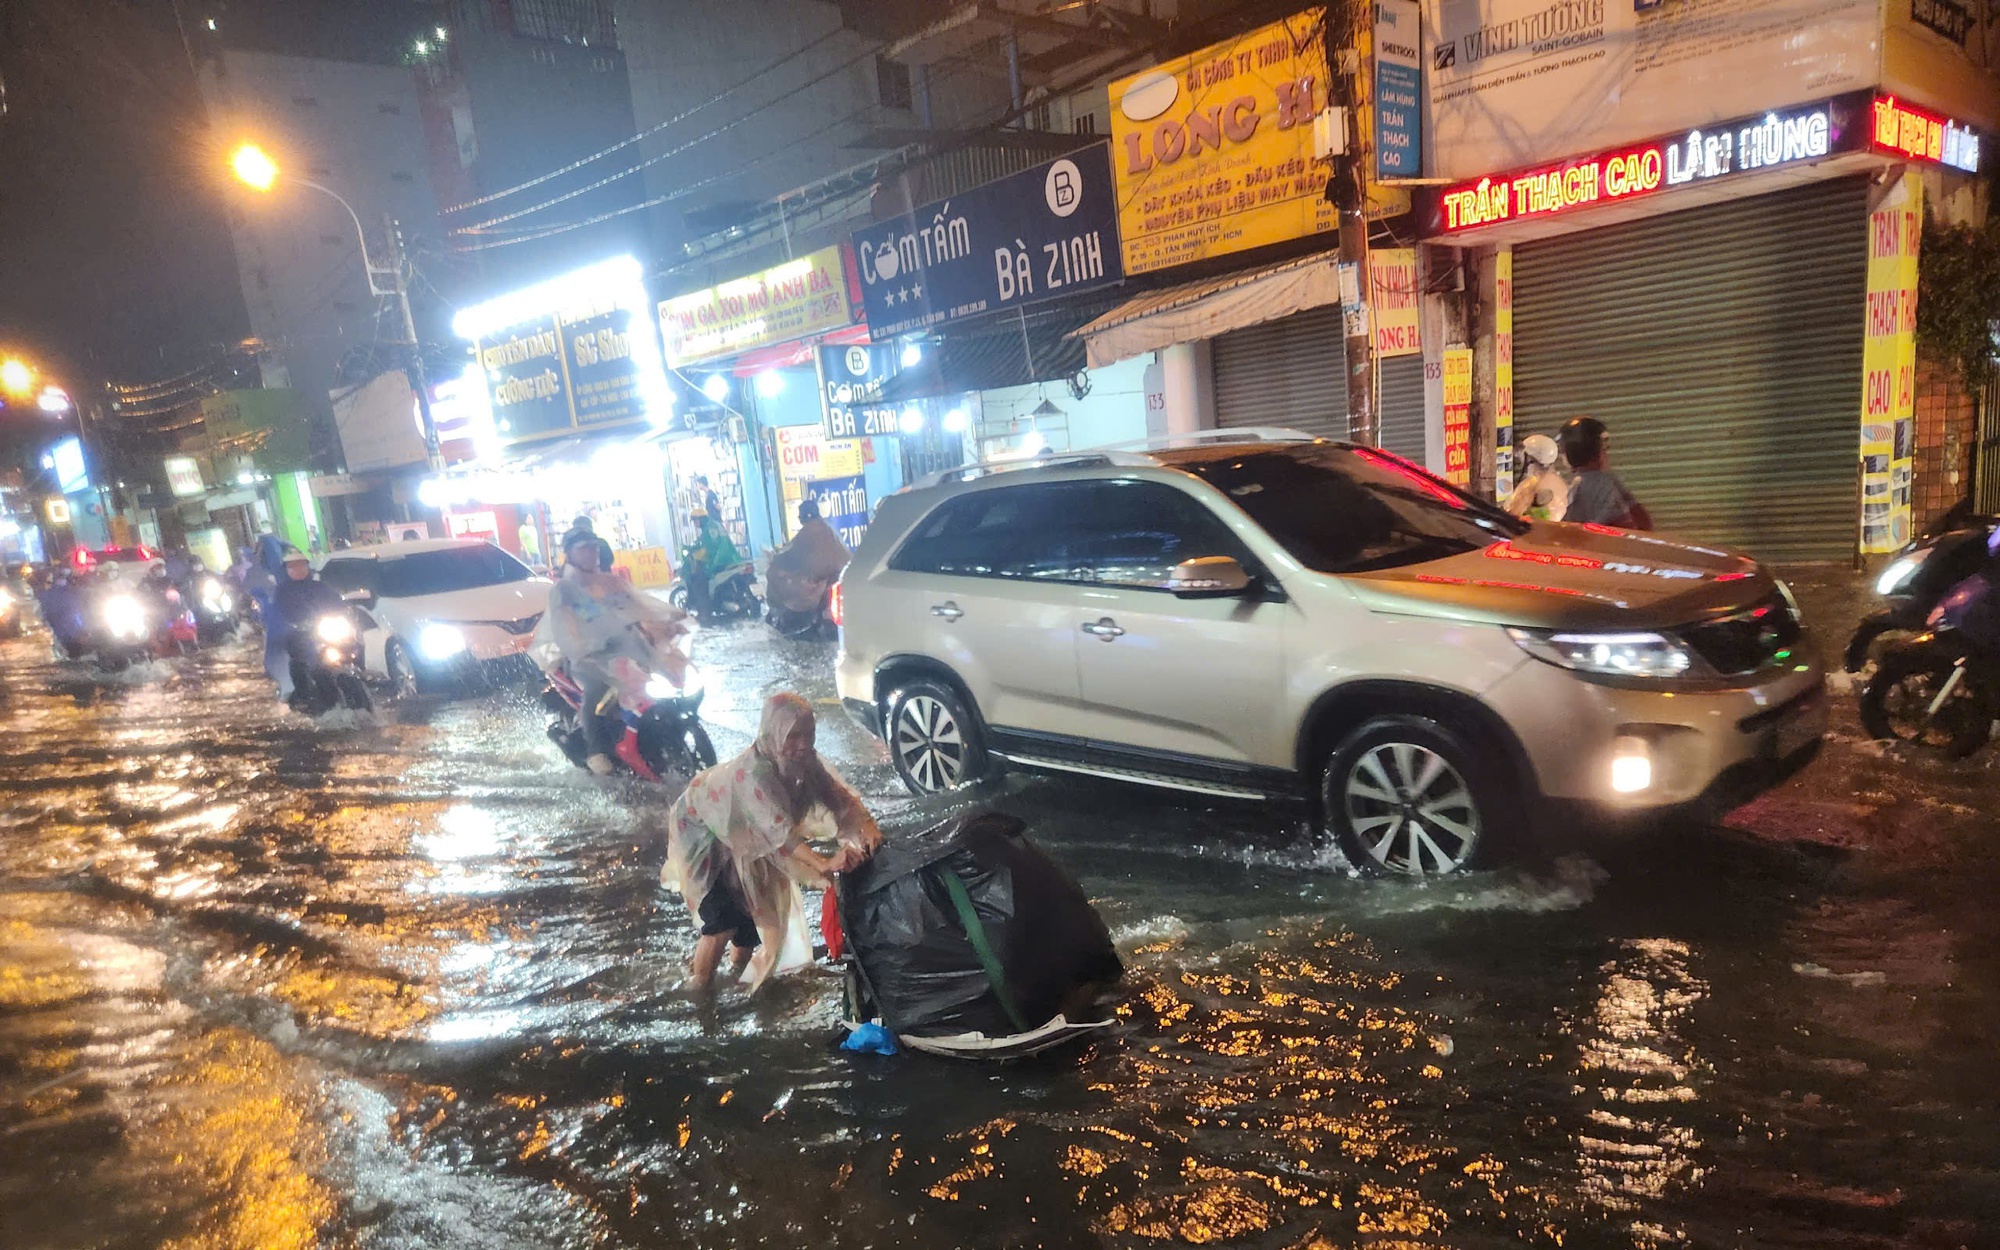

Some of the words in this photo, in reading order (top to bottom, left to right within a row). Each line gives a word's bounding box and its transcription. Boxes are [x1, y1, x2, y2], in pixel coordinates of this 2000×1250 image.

[1464, 20, 1519, 62] VĨNH
[1532, 27, 1604, 56] SAINT-GOBAIN
[1589, 50, 1605, 60] CAO
[1204, 58, 1234, 86] CÔNG
[1237, 50, 1252, 75] TY
[1256, 40, 1288, 69] TNHH
[1124, 95, 1261, 174] LONG
[1276, 75, 1315, 130] H
[1383, 131, 1409, 149] THẠCH
[1383, 151, 1401, 167] CAO
[1444, 178, 1509, 229] TRẦN
[1513, 163, 1599, 212] THẠCH
[1605, 149, 1662, 197] CAO
[1667, 128, 1734, 185] LÂM
[1739, 112, 1829, 169] HÙNG
[1170, 186, 1203, 206] KHÓA
[1206, 178, 1231, 197] KÉO
[1276, 158, 1305, 178] KÉO
[1226, 191, 1256, 212] LIỆU
[1259, 182, 1289, 202] MAY
[920, 201, 970, 266] TẤM
[1164, 233, 1185, 244] PHAN
[1187, 226, 1204, 237] HUY
[1223, 230, 1243, 240] HCM
[994, 238, 1034, 301] BÀ
[1043, 231, 1104, 289] ZINH
[773, 275, 806, 303] ANH
[574, 333, 598, 367] SC
[598, 327, 630, 362] Sho
[1379, 326, 1405, 351] ONG
[1425, 363, 1442, 379] 133
[1148, 393, 1165, 410] 133
[1497, 387, 1511, 418] CAO
[1867, 370, 1891, 415] CAO
[830, 406, 856, 436] BÀ
[863, 409, 899, 435] ZINH
[783, 444, 819, 465] CƠM
[842, 478, 866, 515] TẤM
[840, 524, 867, 547] ZIN
